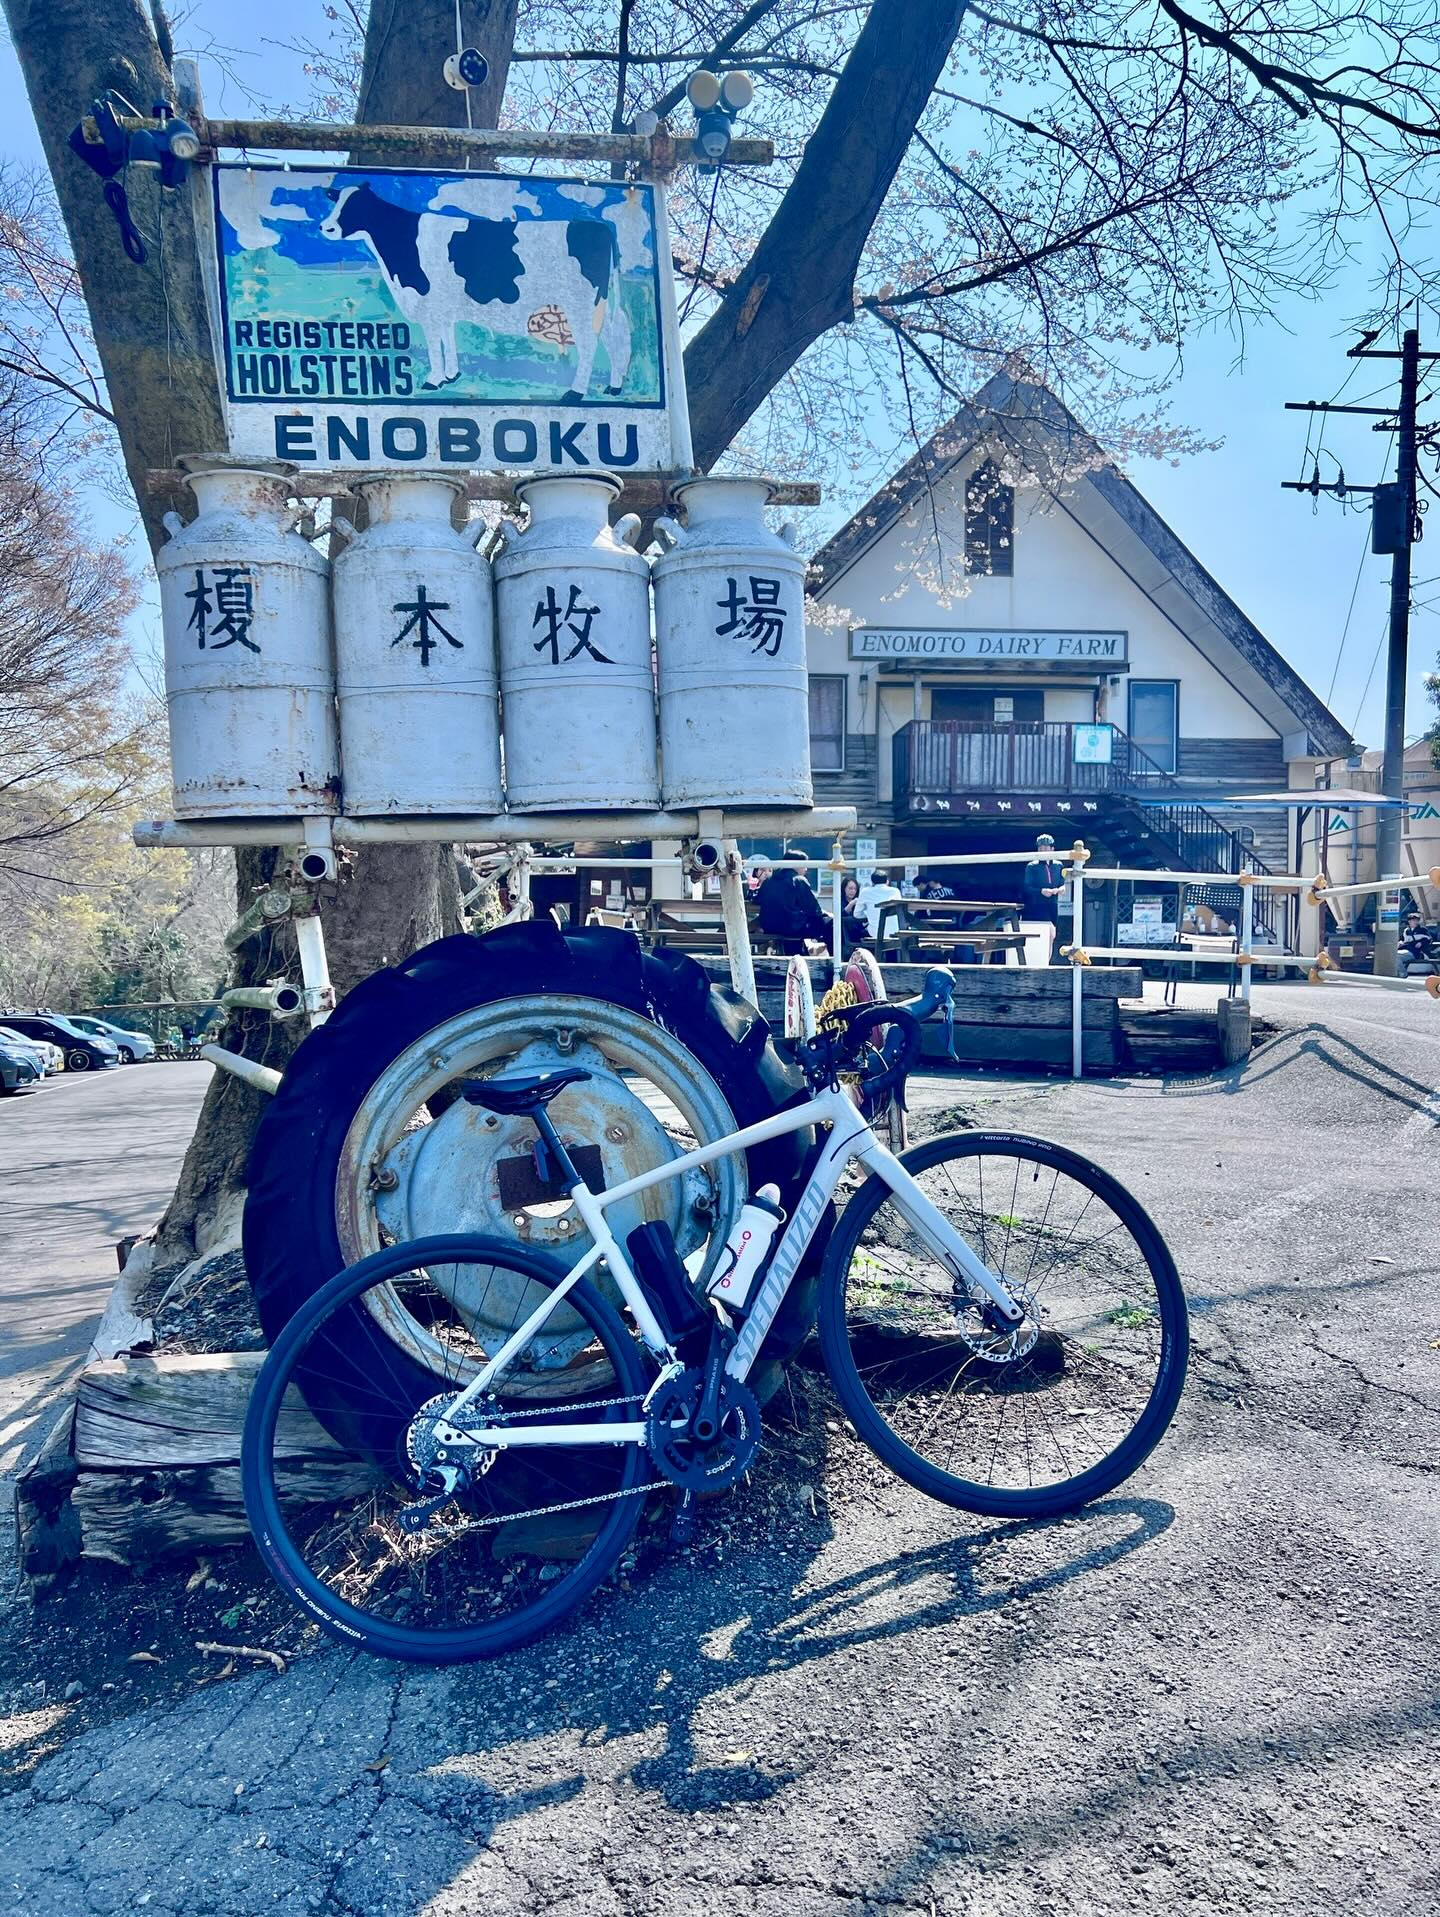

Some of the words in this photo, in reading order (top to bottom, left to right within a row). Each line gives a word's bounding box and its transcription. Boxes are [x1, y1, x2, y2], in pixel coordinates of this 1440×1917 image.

[235, 320, 410, 350] REGISTERED
[237, 354, 413, 395] HOLSTEINS
[275, 415, 639, 466] ENOBOKU
[862, 635, 966, 653] ENOMOTO
[978, 637, 1046, 655] DAIRY
[1057, 638, 1118, 656] FARM
[733, 1180, 826, 1364] SPECIALIZED
